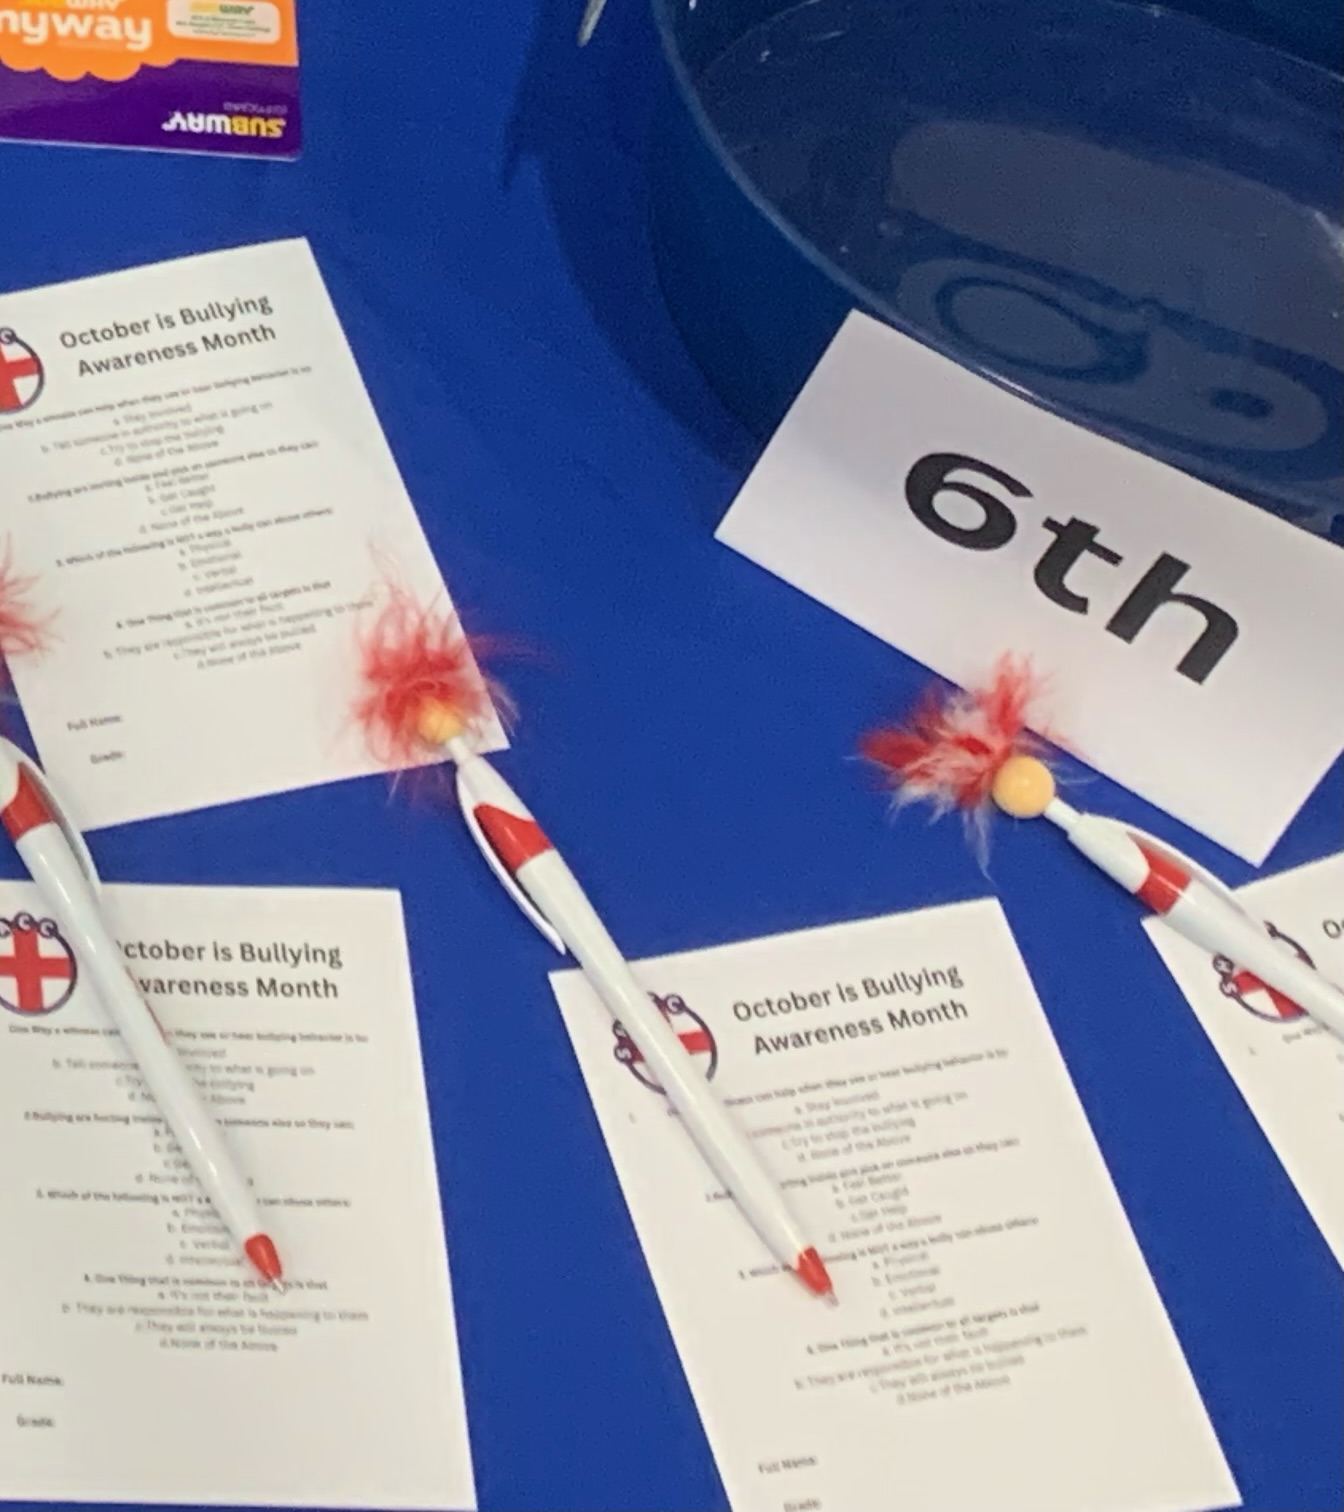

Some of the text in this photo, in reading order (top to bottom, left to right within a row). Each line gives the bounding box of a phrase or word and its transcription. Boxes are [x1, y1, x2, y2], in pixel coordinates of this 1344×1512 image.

[161, 110, 287, 138] SUBWAY
[58, 295, 274, 350] October is Bullying
[78, 323, 277, 378] Awareness Month
[903, 452, 1241, 686] 6th
[212, 940, 234, 963] is
[238, 941, 344, 971] Bullying
[255, 976, 339, 999] Month
[731, 965, 965, 1023] October is Bullying
[754, 998, 969, 1056] Awareness Month
